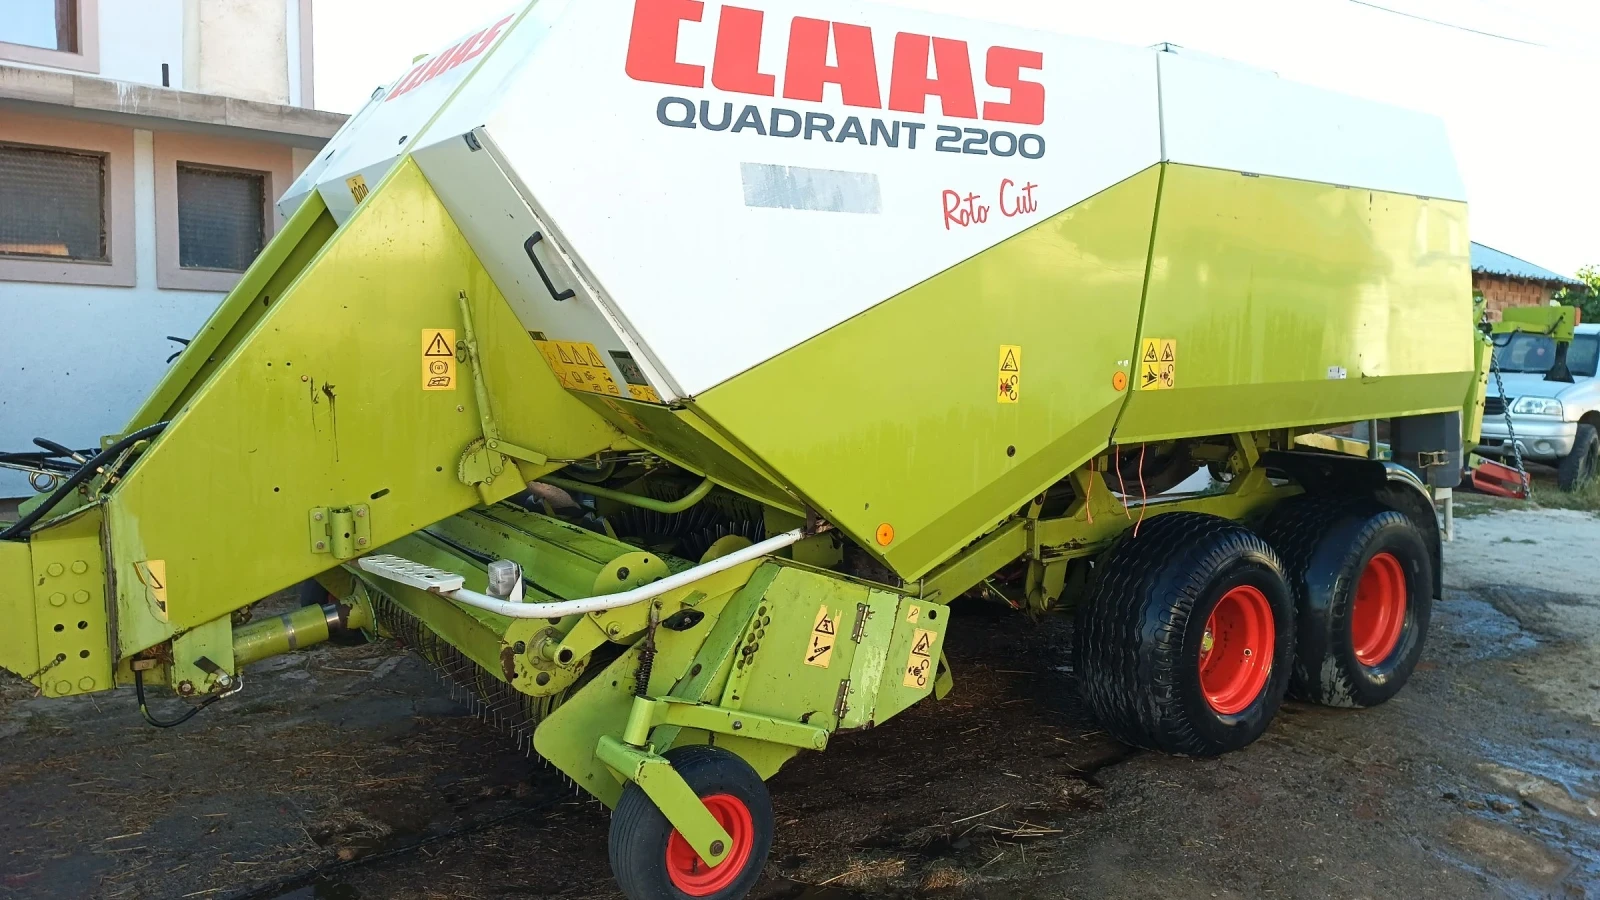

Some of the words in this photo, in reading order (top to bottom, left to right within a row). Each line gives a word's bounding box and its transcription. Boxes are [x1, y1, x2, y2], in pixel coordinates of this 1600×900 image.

[384, 13, 515, 102] CLAAS
[625, 0, 1046, 126] CLAAS
[656, 96, 926, 150] QUADRANT
[935, 124, 1047, 160] 2200
[942, 189, 990, 231] Roto
[999, 178, 1038, 217] Cut
